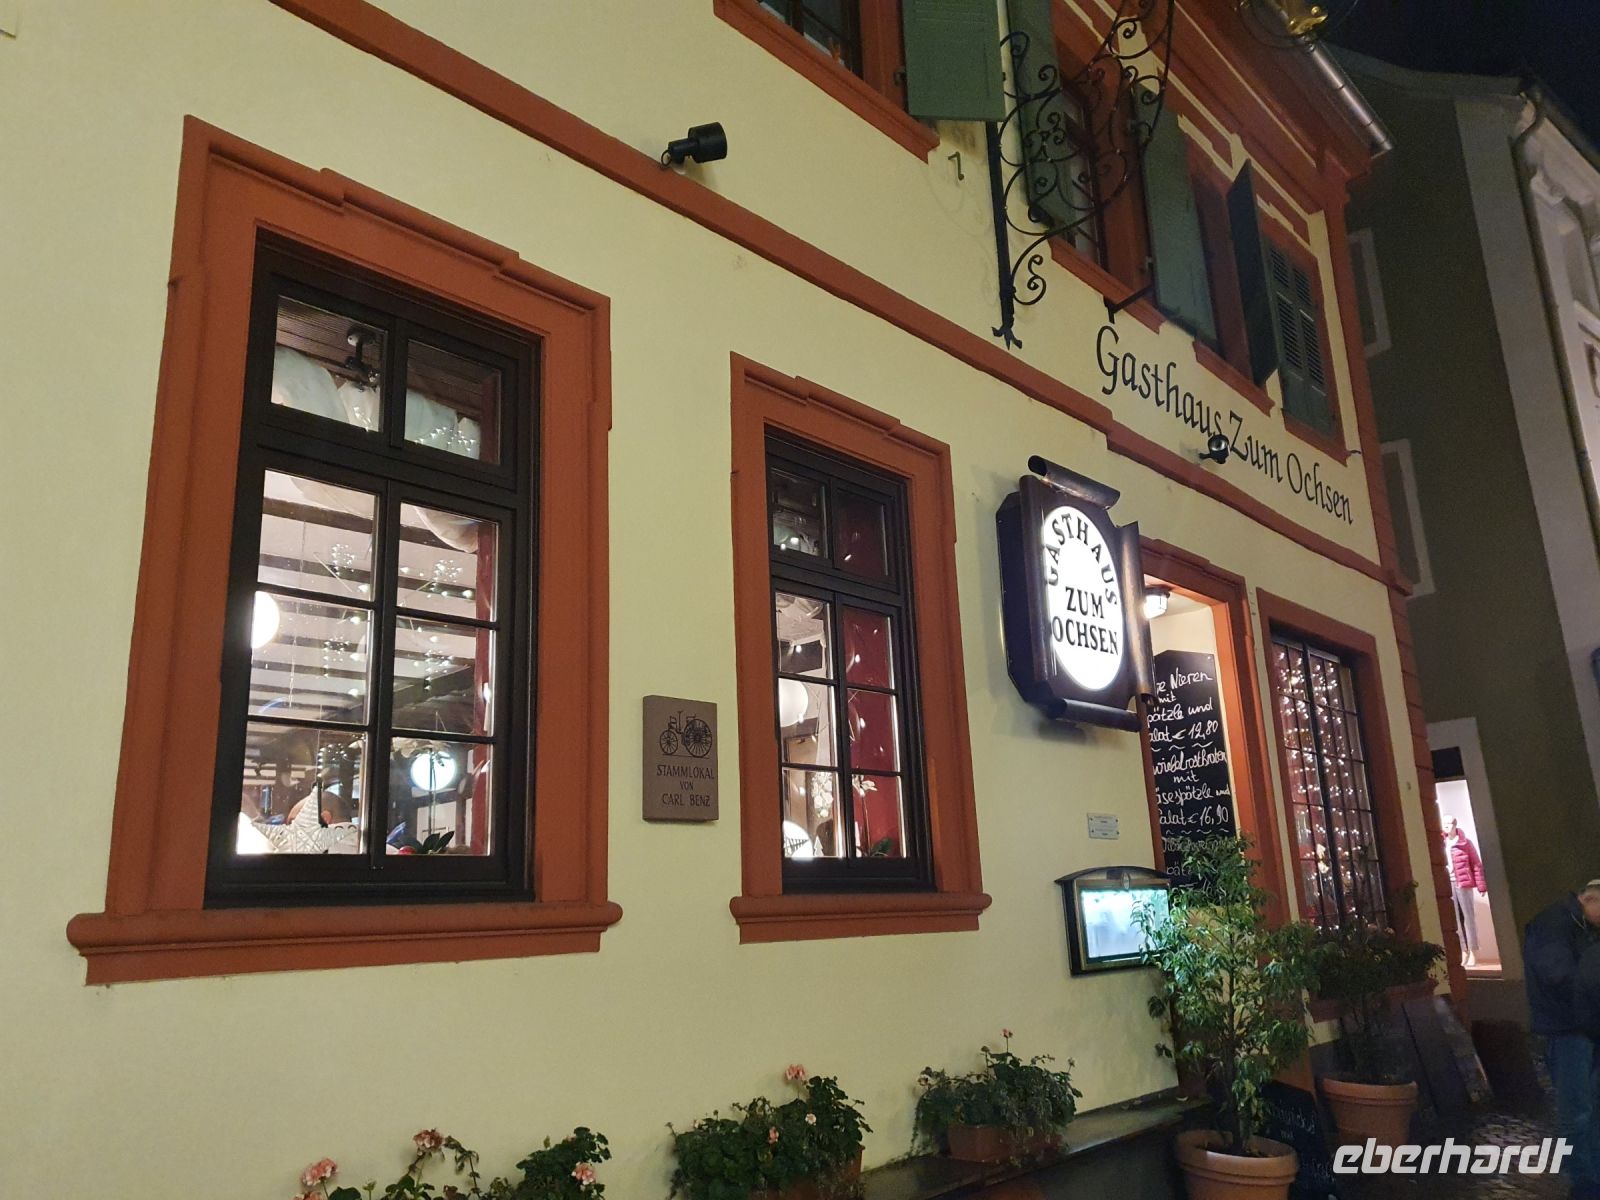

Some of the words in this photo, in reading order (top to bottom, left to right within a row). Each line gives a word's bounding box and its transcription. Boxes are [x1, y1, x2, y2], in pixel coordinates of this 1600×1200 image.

[1096, 325, 1222, 437] Gasthaus
[1229, 410, 1282, 482] Zum
[1286, 453, 1353, 524] Ochsen
[1045, 513, 1118, 605] GASTHAUS
[1065, 586, 1104, 619] ZUM
[1053, 615, 1118, 655] OCHSEN
[1170, 667, 1213, 690] Nieren
[1158, 690, 1176, 703] mit
[1147, 703, 1184, 728] pätzle
[1188, 697, 1213, 715] und
[1149, 726, 1172, 742] alat
[656, 764, 715, 780] STAMMLOKAL
[1173, 769, 1199, 784] mit
[680, 781, 694, 791] VON
[662, 793, 684, 806] CARL
[690, 794, 710, 807] BENZ
[1158, 808, 1187, 825] alat
